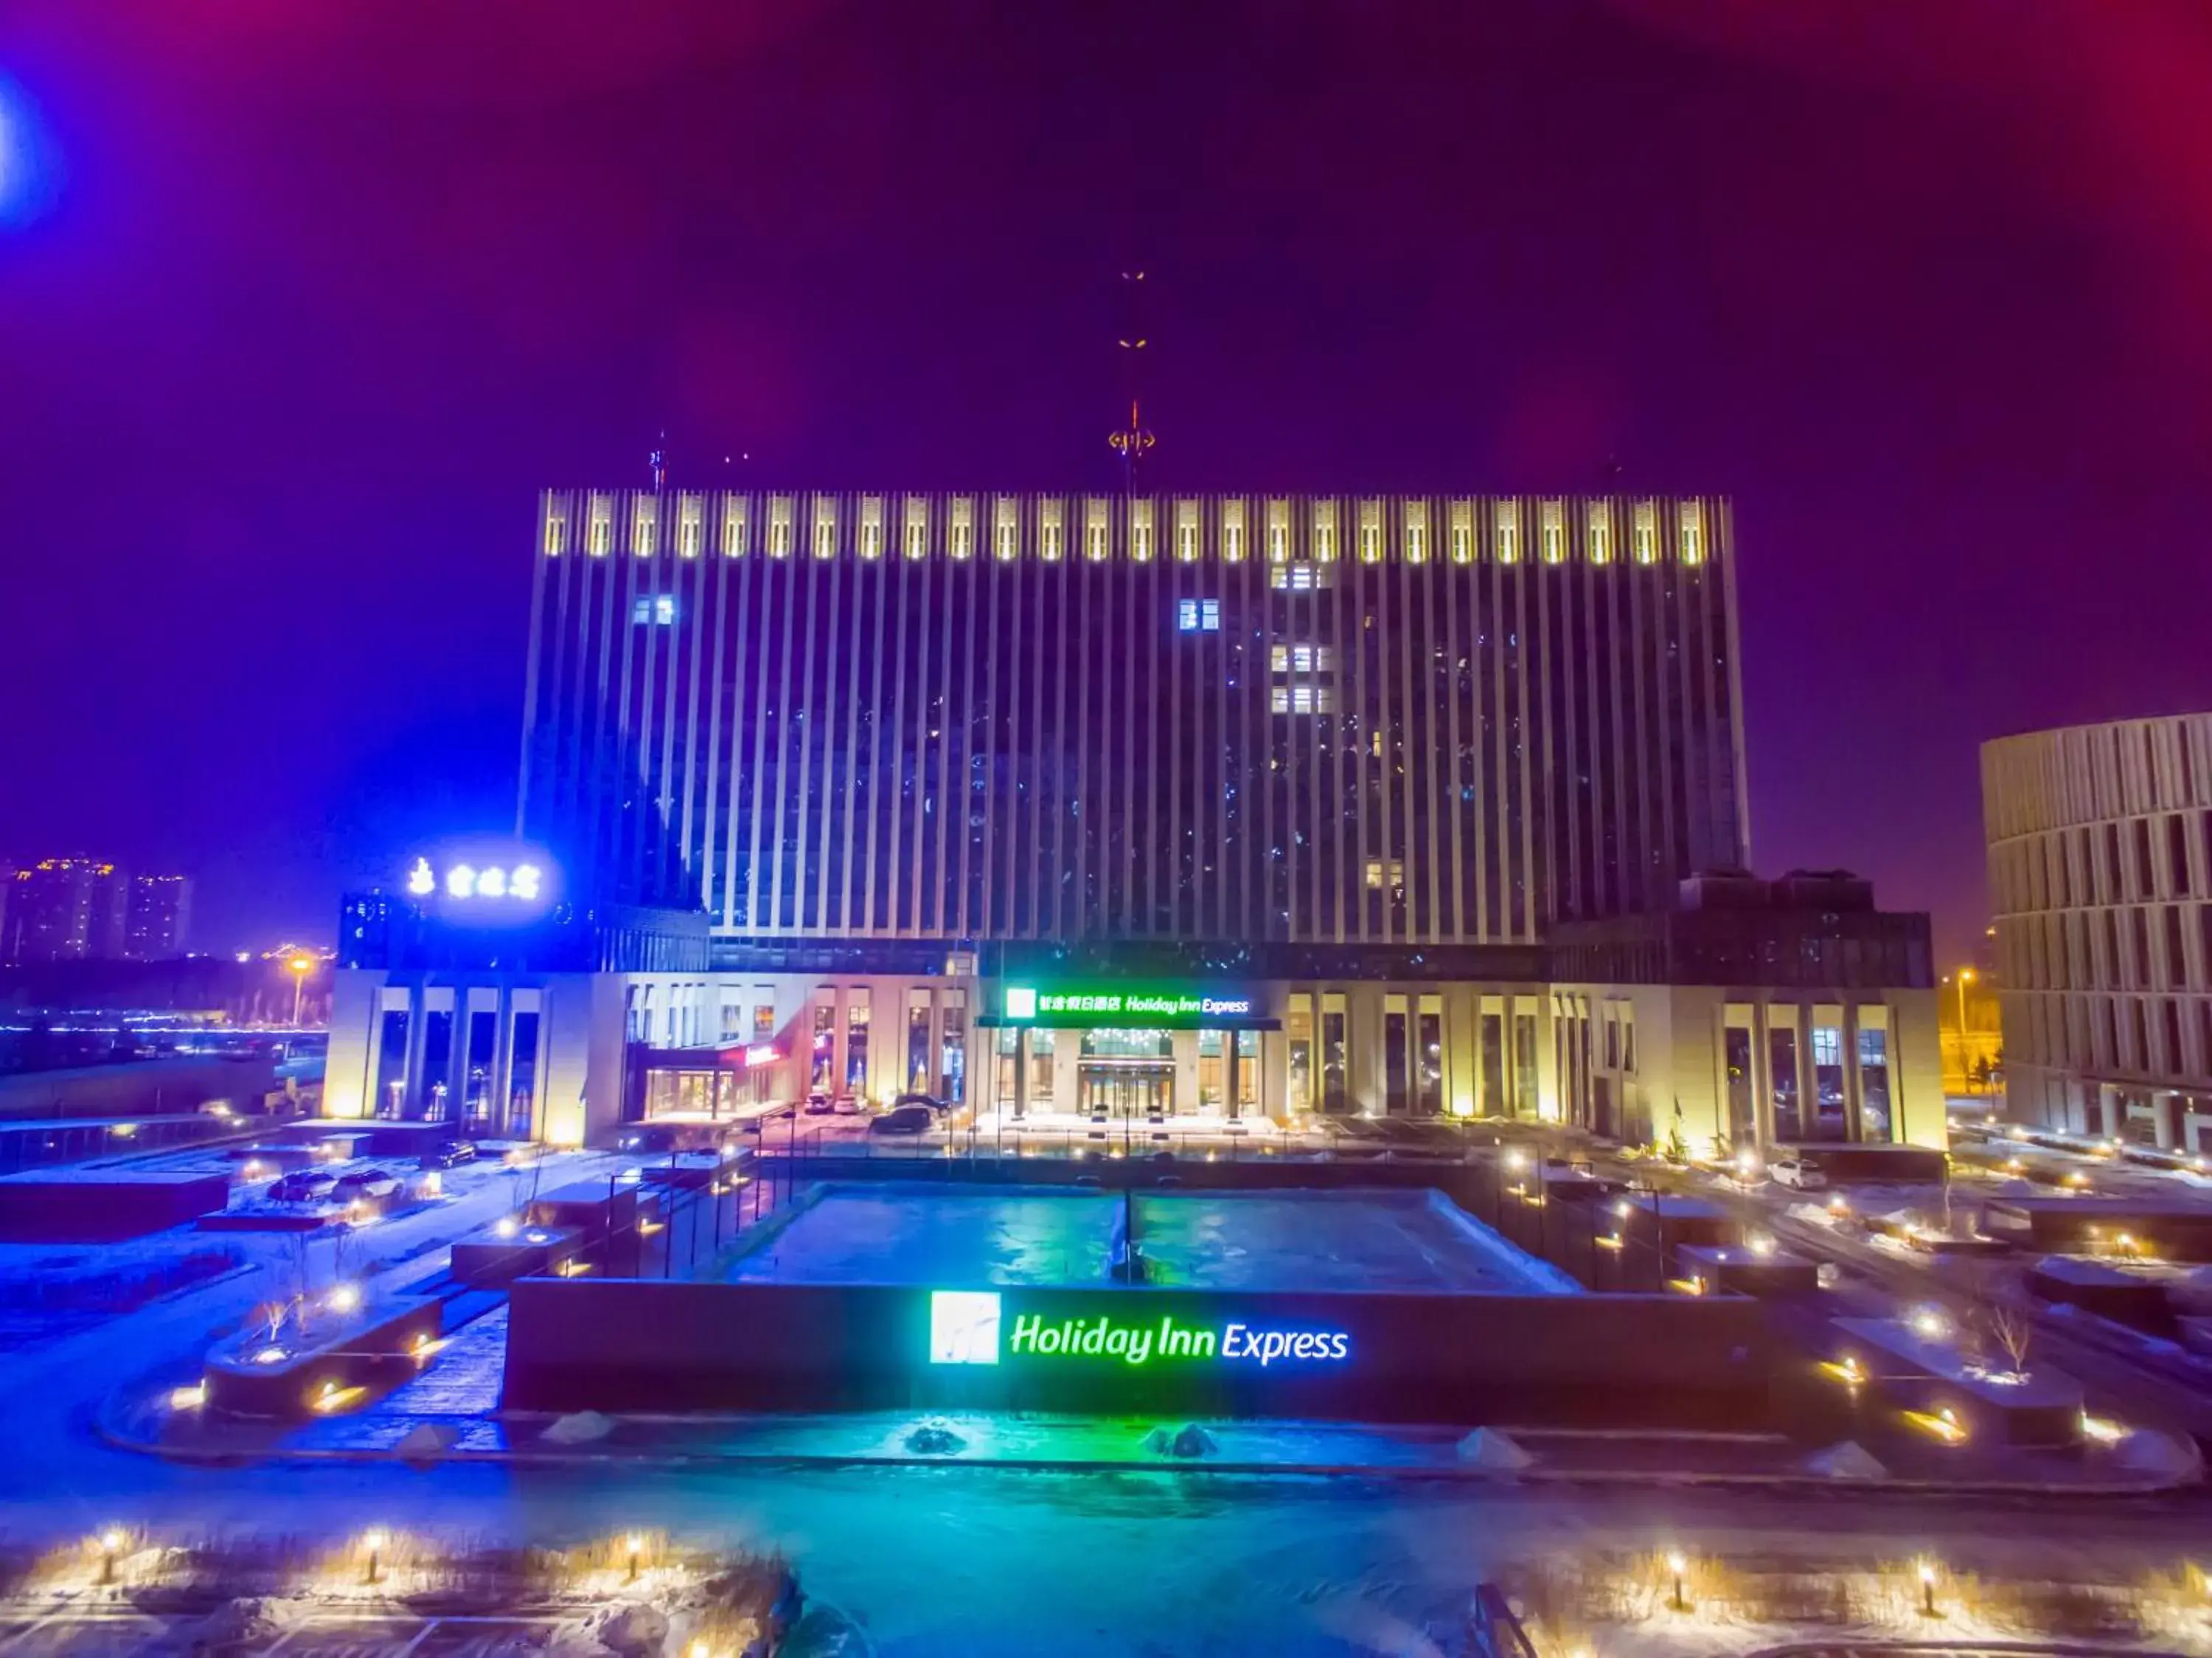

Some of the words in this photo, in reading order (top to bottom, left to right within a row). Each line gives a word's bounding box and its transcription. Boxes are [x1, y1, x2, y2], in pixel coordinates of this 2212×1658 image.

[1126, 996, 1178, 1015] Holiday
[1179, 996, 1200, 1012] Inn
[1202, 998, 1248, 1014] Express
[1011, 1315, 1151, 1364] Holiday
[1158, 1317, 1214, 1356] Inn
[1221, 1324, 1349, 1365] Express
